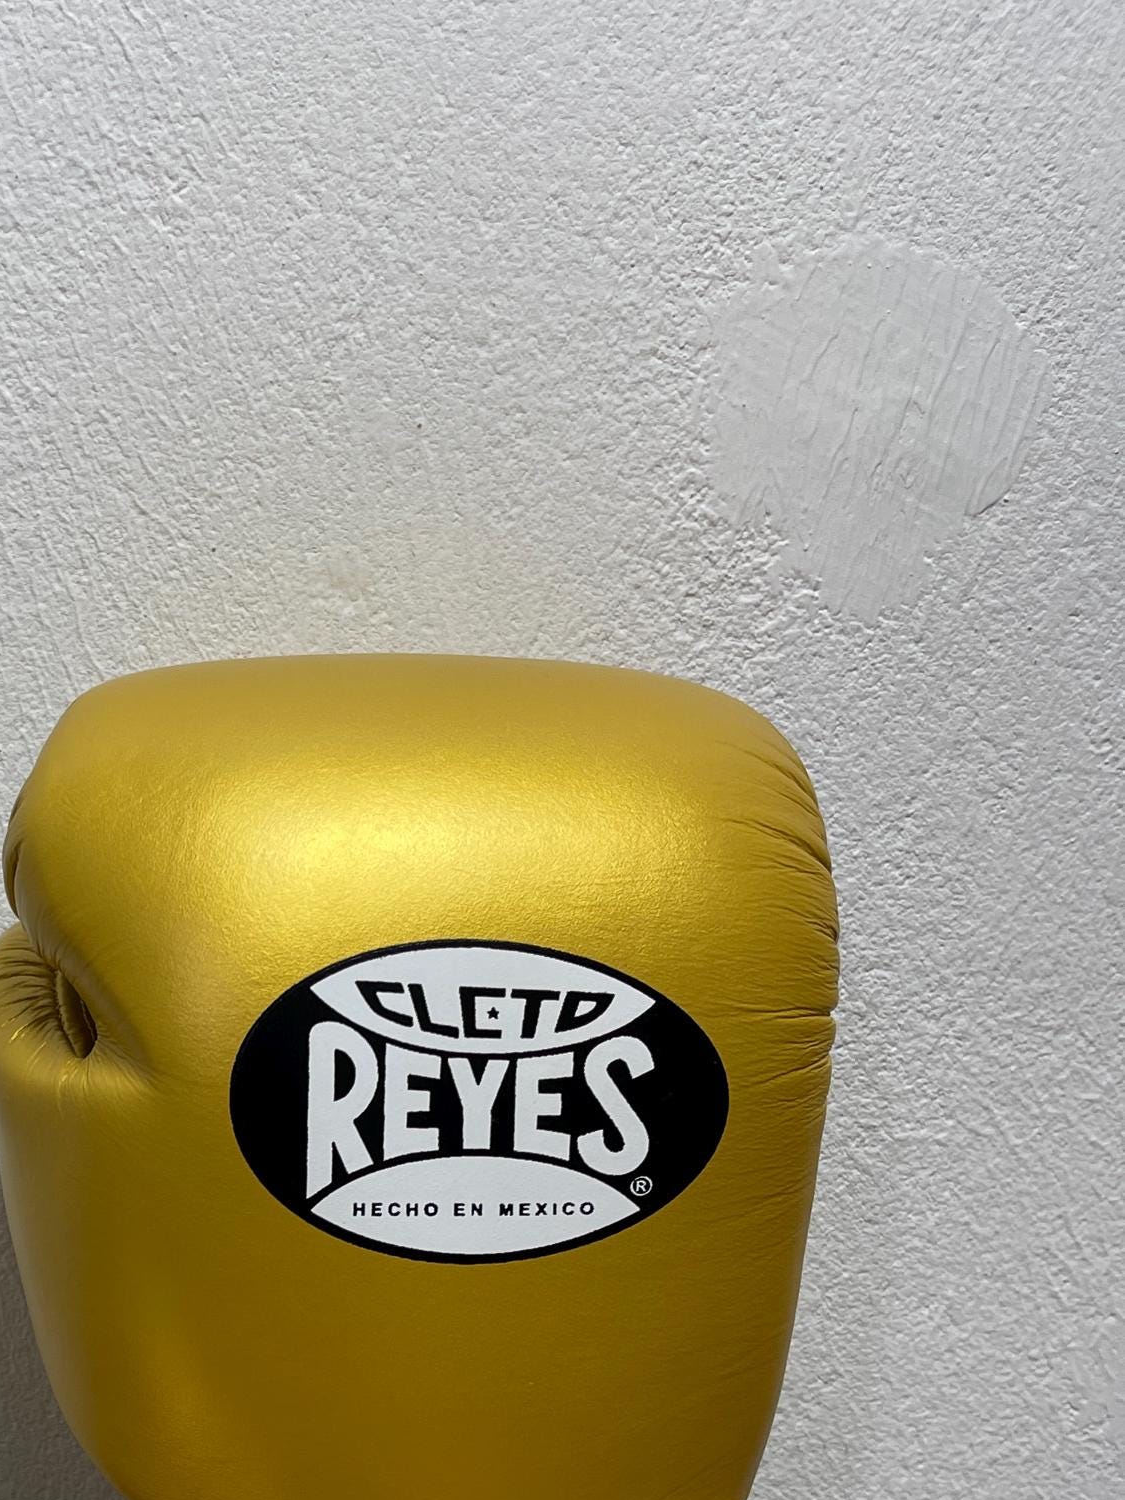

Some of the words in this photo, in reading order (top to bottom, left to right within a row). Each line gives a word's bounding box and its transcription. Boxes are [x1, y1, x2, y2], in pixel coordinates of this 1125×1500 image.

[306, 1020, 655, 1199] REYES
[352, 1201, 439, 1218] HECHO
[453, 1201, 483, 1218] EN
[498, 1201, 595, 1217] MEXICO
